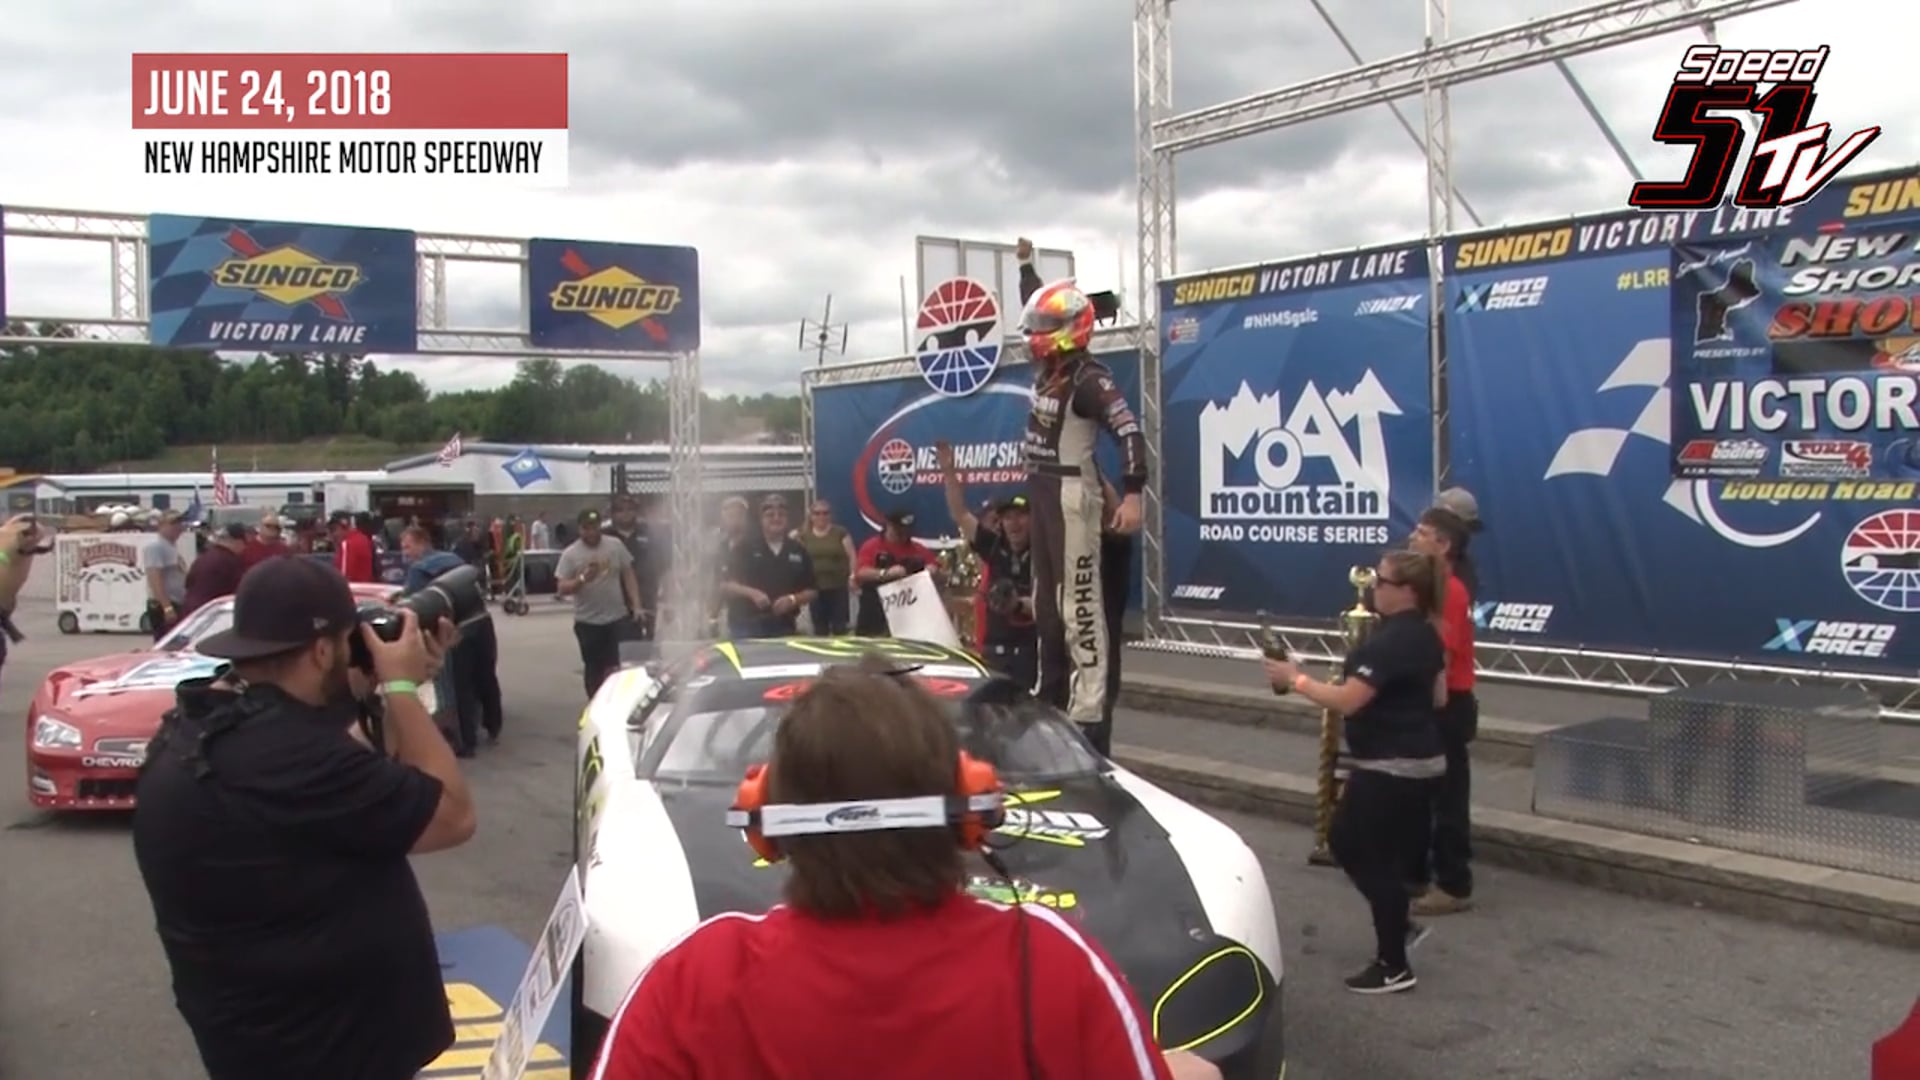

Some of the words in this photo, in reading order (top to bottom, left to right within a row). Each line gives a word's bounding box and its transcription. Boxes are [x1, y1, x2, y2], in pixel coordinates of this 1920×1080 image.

[1455, 228, 1573, 269] SUNOCO
[1578, 212, 1698, 252] VICTORY
[1711, 206, 1794, 235] LANE
[1781, 233, 1902, 265] NEW
[220, 263, 356, 289] SUNOCO
[1174, 273, 1255, 305] SUNOCO
[1259, 260, 1343, 293] VICTORY
[1350, 251, 1408, 280] LANE
[1491, 277, 1548, 295] MOTO
[555, 284, 677, 311] SUNOCO
[1486, 292, 1543, 311] RACE
[1768, 296, 1920, 338] SHO
[209, 321, 303, 340] VICTORY
[310, 326, 367, 343] LANE
[1690, 376, 1920, 431] VICTOR
[1200, 367, 1404, 489] MOAT
[917, 472, 963, 484] MOTR
[1210, 483, 1379, 515] mountain
[1200, 524, 1244, 541] ROAD
[1249, 526, 1318, 542] COURSE
[1324, 528, 1389, 544] SERIES
[1076, 554, 1099, 668] LANPHER
[1496, 603, 1554, 619] MOTO
[1489, 617, 1547, 632] RACE
[1816, 620, 1896, 641] MOTO
[1806, 638, 1888, 657] RACE
